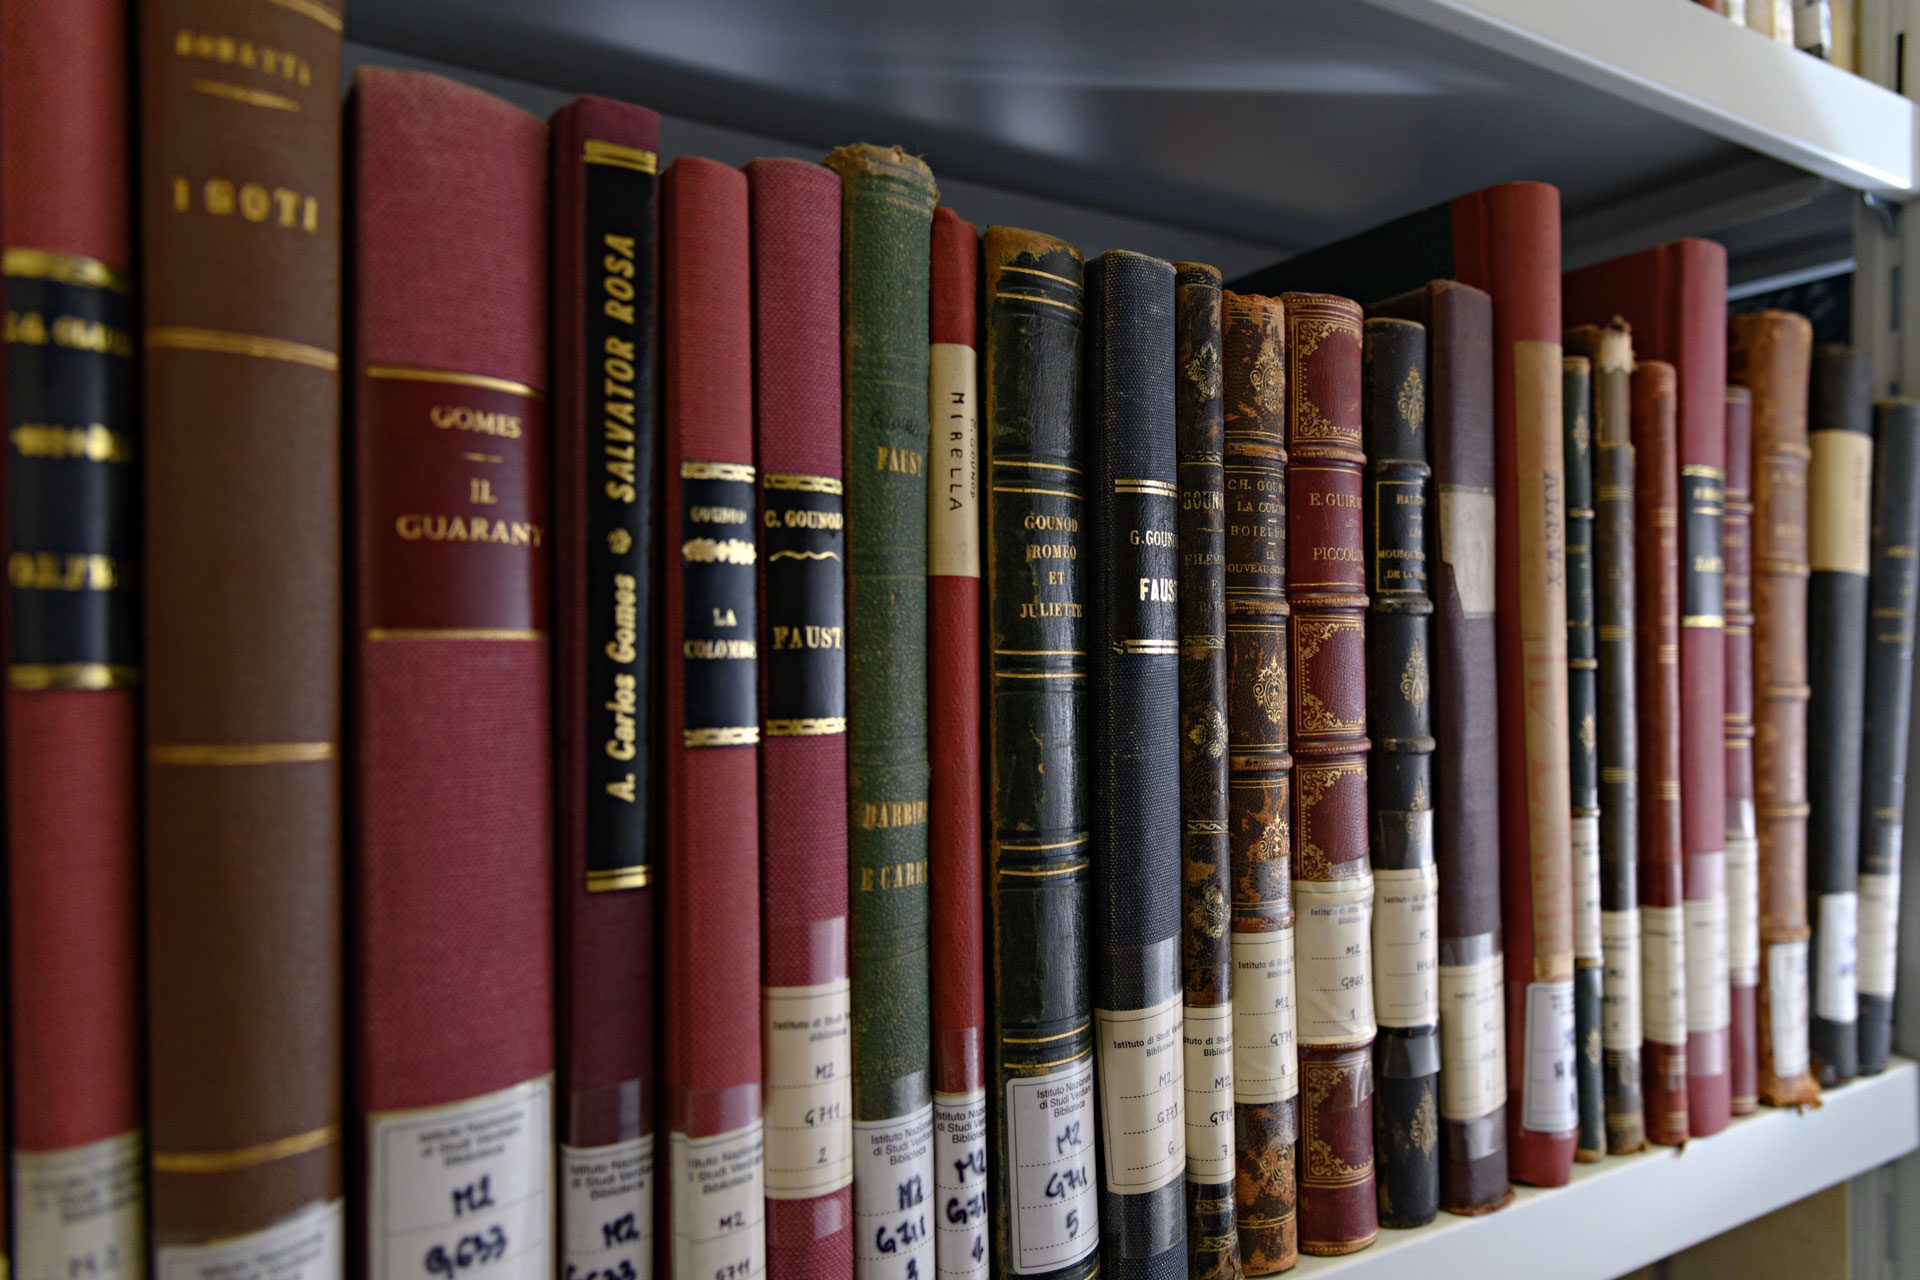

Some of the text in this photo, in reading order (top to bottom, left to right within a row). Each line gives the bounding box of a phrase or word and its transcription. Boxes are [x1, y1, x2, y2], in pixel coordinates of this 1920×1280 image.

[204, 176, 318, 232] GOTI
[430, 404, 523, 439] GOMES
[948, 391, 966, 512] MIRELLA
[470, 476, 498, 505] IL
[1227, 480, 1253, 490] CH.
[1237, 501, 1254, 512] LA
[1309, 492, 1324, 506] E.
[602, 232, 637, 804] A. Carlos Gomes SALVATOR ROSA
[764, 509, 844, 531] C. GOUNOD
[1024, 513, 1079, 533] GOUNOD
[1031, 543, 1077, 560] ROMEO
[1224, 563, 1269, 574] OUVEAU
[1048, 570, 1065, 586] ET
[712, 606, 739, 628] LA
[1020, 602, 1083, 619] JULIETTE
[773, 625, 843, 651] FAUST
[1345, 944, 1361, 956] M2
[1238, 960, 1267, 969] Istituto
[1113, 1040, 1145, 1049] Istituto
[1147, 1036, 1154, 1045] di
[1206, 1037, 1213, 1046] di
[815, 1061, 836, 1080] M2
[1214, 1074, 1231, 1089] M2
[1037, 1087, 1065, 1099] Istituto
[1039, 1101, 1048, 1110] di
[1050, 1095, 1070, 1108] Studi
[1054, 1099, 1086, 1118] Biblioteca
[937, 1123, 945, 1132] di
[947, 1121, 972, 1133] Studi
[871, 1131, 903, 1145] Istituto
[816, 1147, 829, 1165] 2
[886, 1140, 909, 1155] Studi
[719, 1211, 745, 1231] M2
[1065, 1208, 1080, 1239] 5
